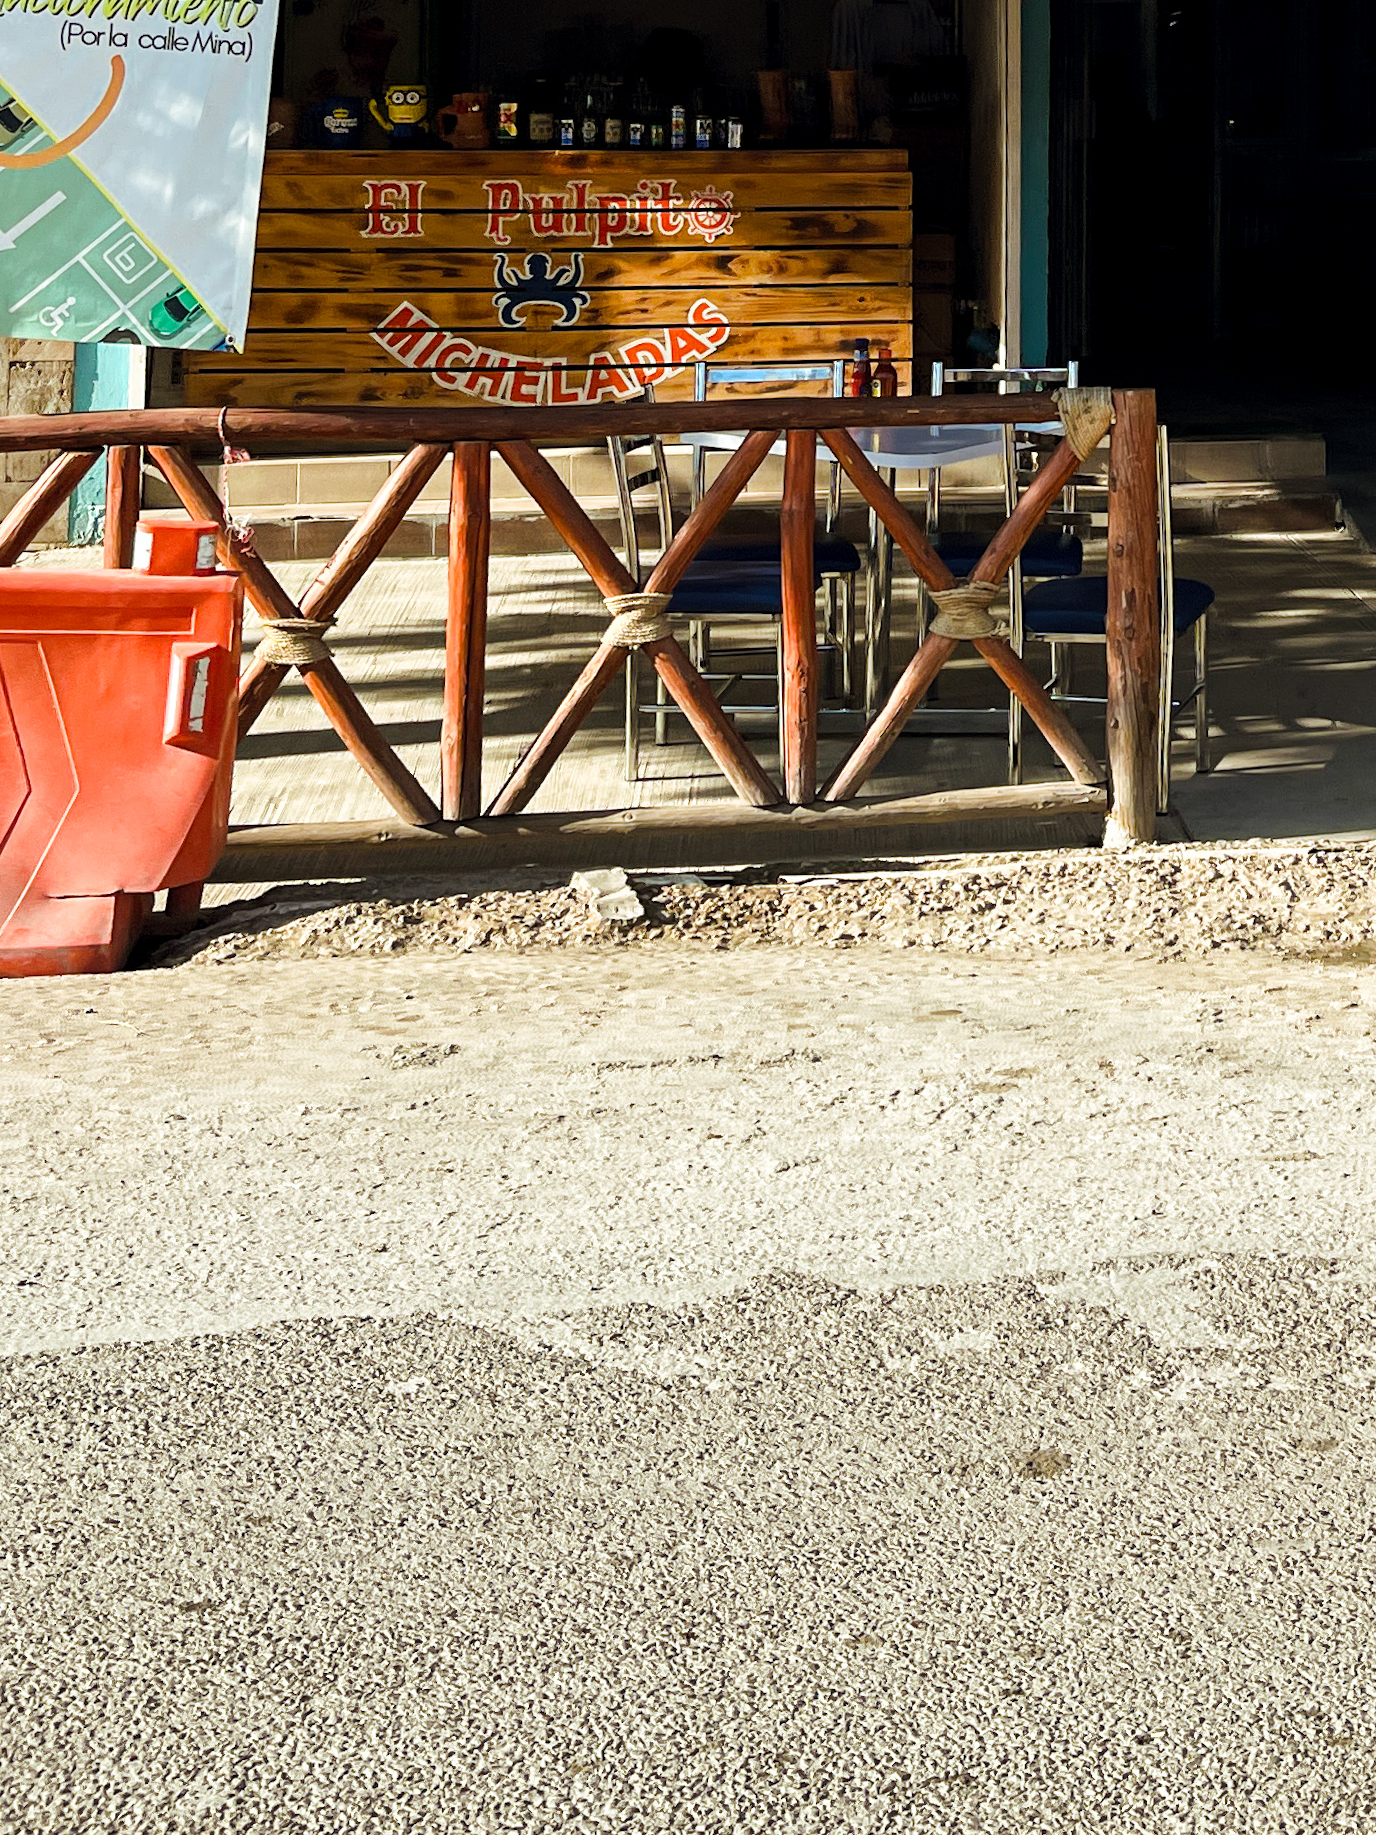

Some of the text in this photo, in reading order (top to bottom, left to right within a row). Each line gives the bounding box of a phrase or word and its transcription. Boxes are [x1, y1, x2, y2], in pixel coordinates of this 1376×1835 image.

[60, 20, 253, 62] (Por la calle Mina)
[361, 178, 740, 246] El Pulpito
[369, 298, 730, 408] MICHELADAS
